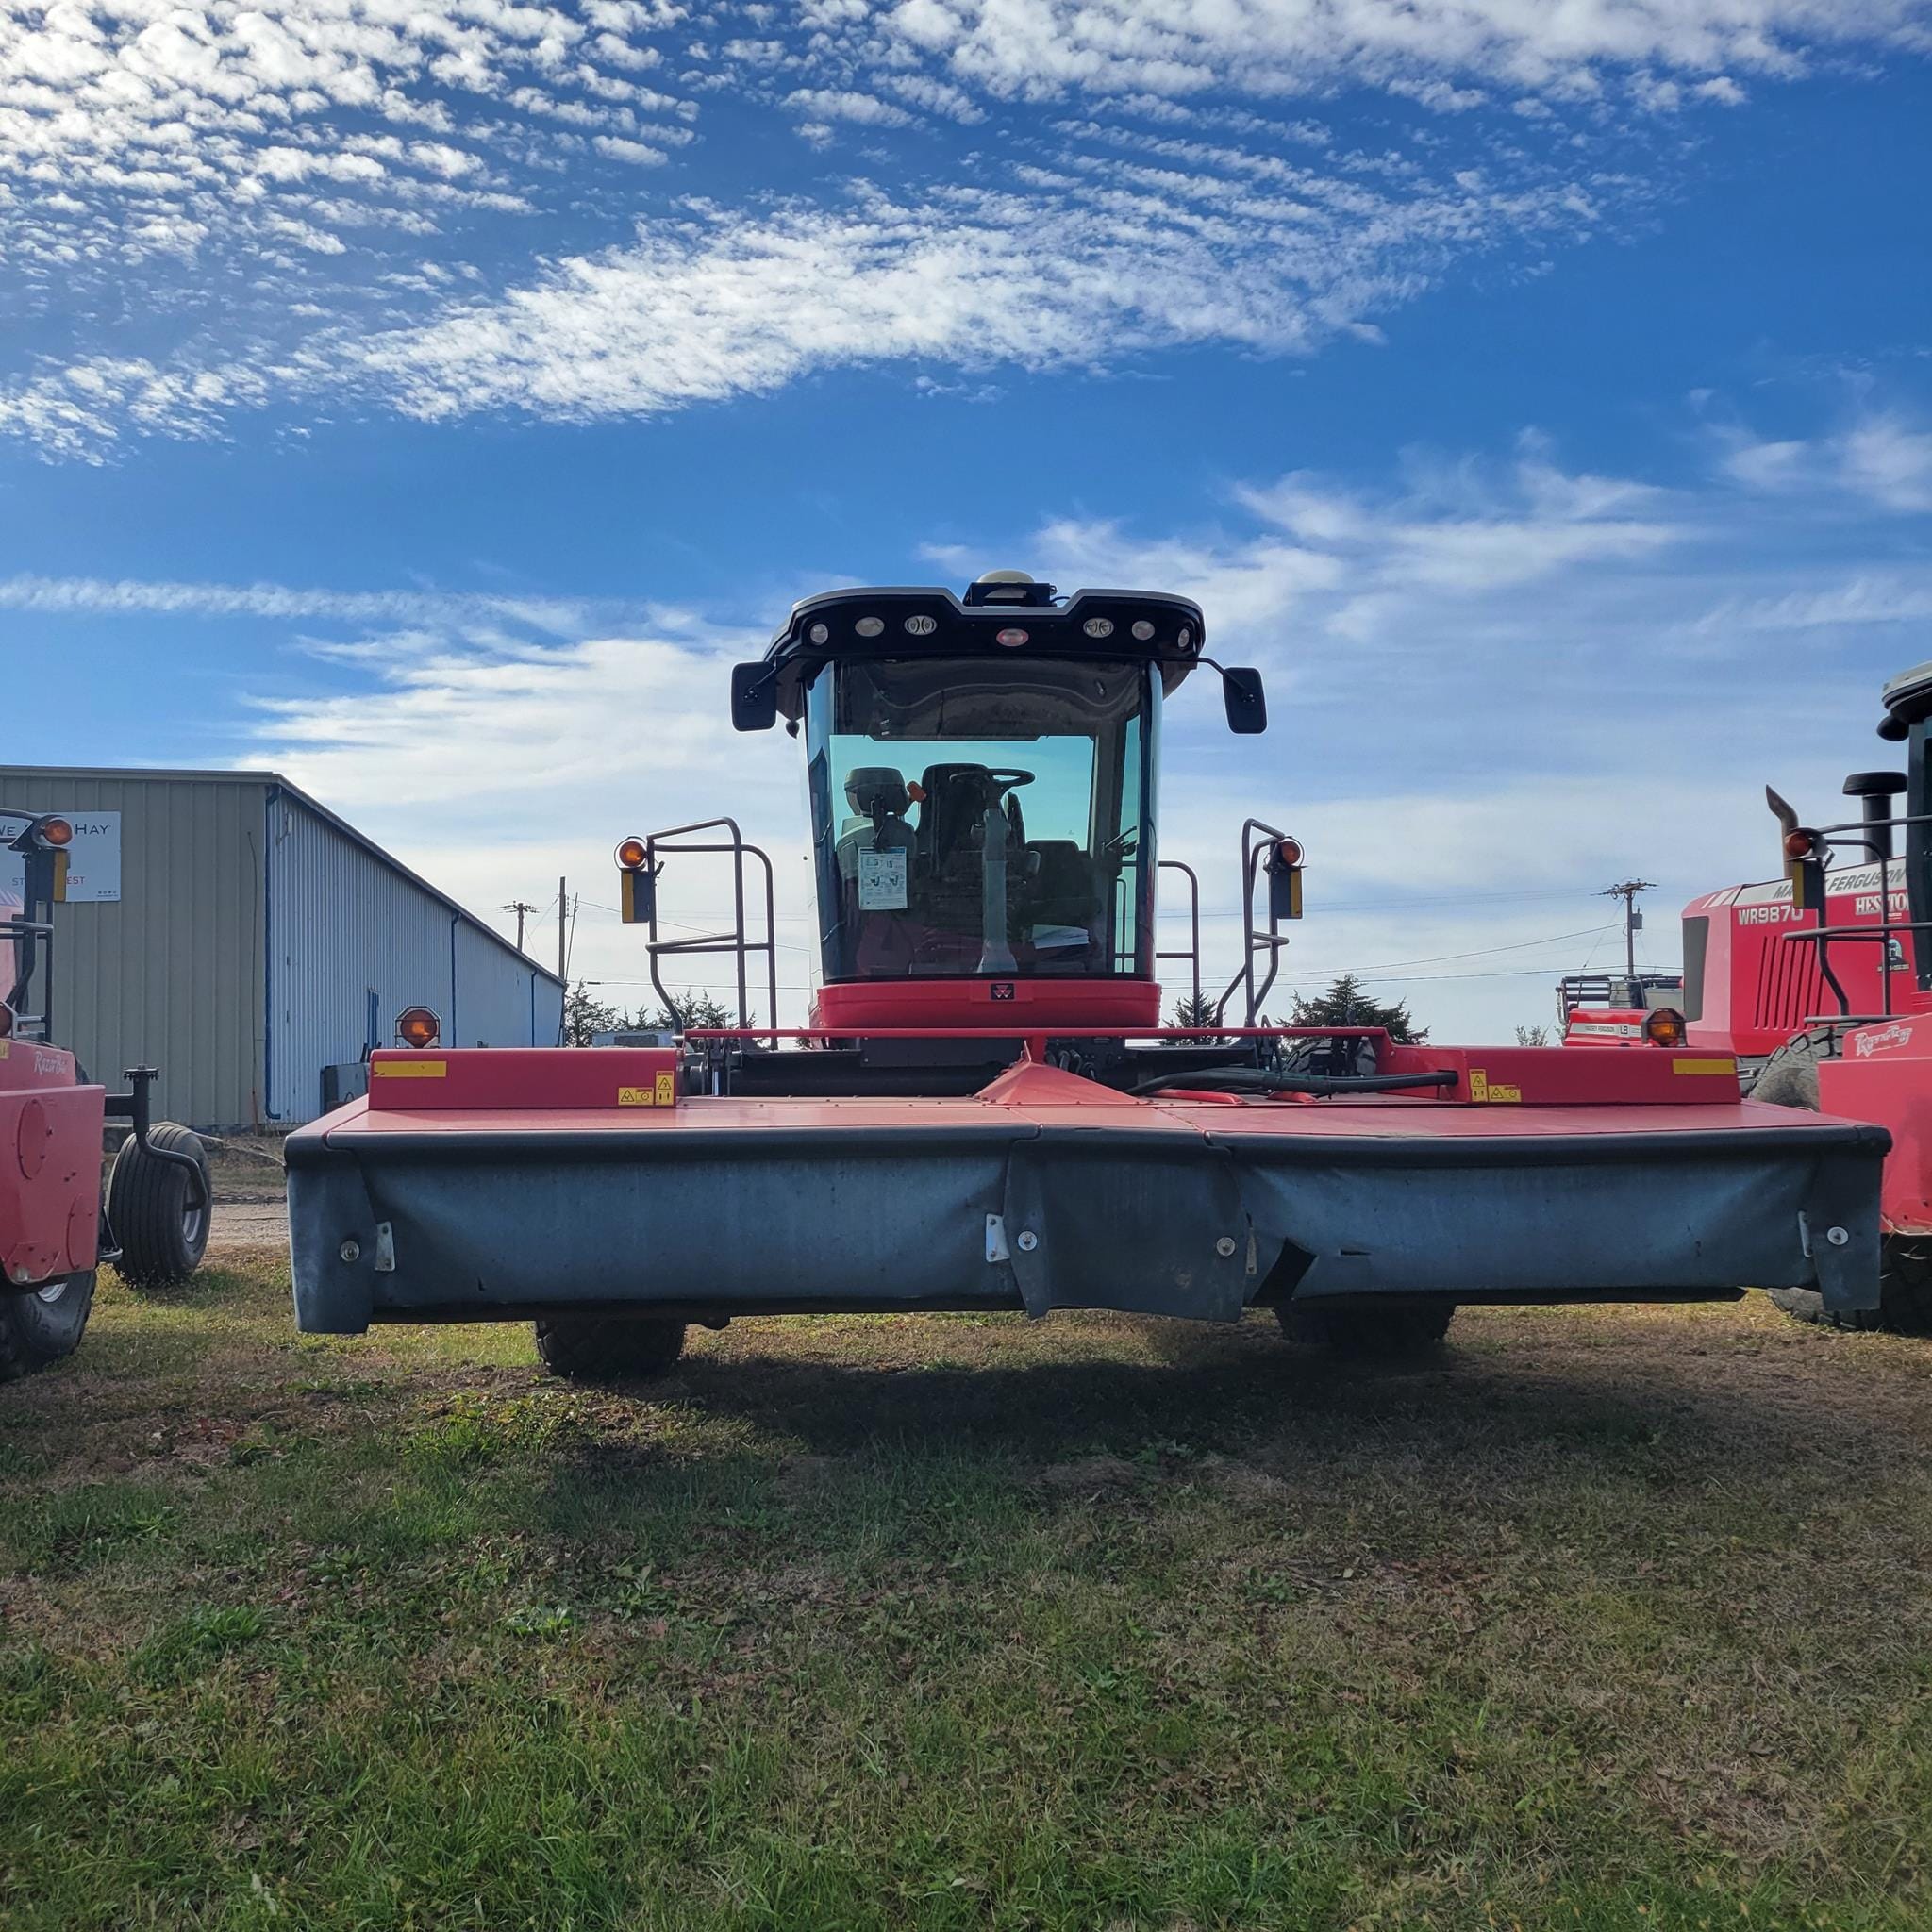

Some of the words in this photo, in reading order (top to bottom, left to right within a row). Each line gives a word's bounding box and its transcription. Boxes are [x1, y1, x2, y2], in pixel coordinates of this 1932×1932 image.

[75, 824, 108, 835] HAY
[1856, 892, 1909, 916] HESTO
[1739, 905, 1804, 925] WR9870
